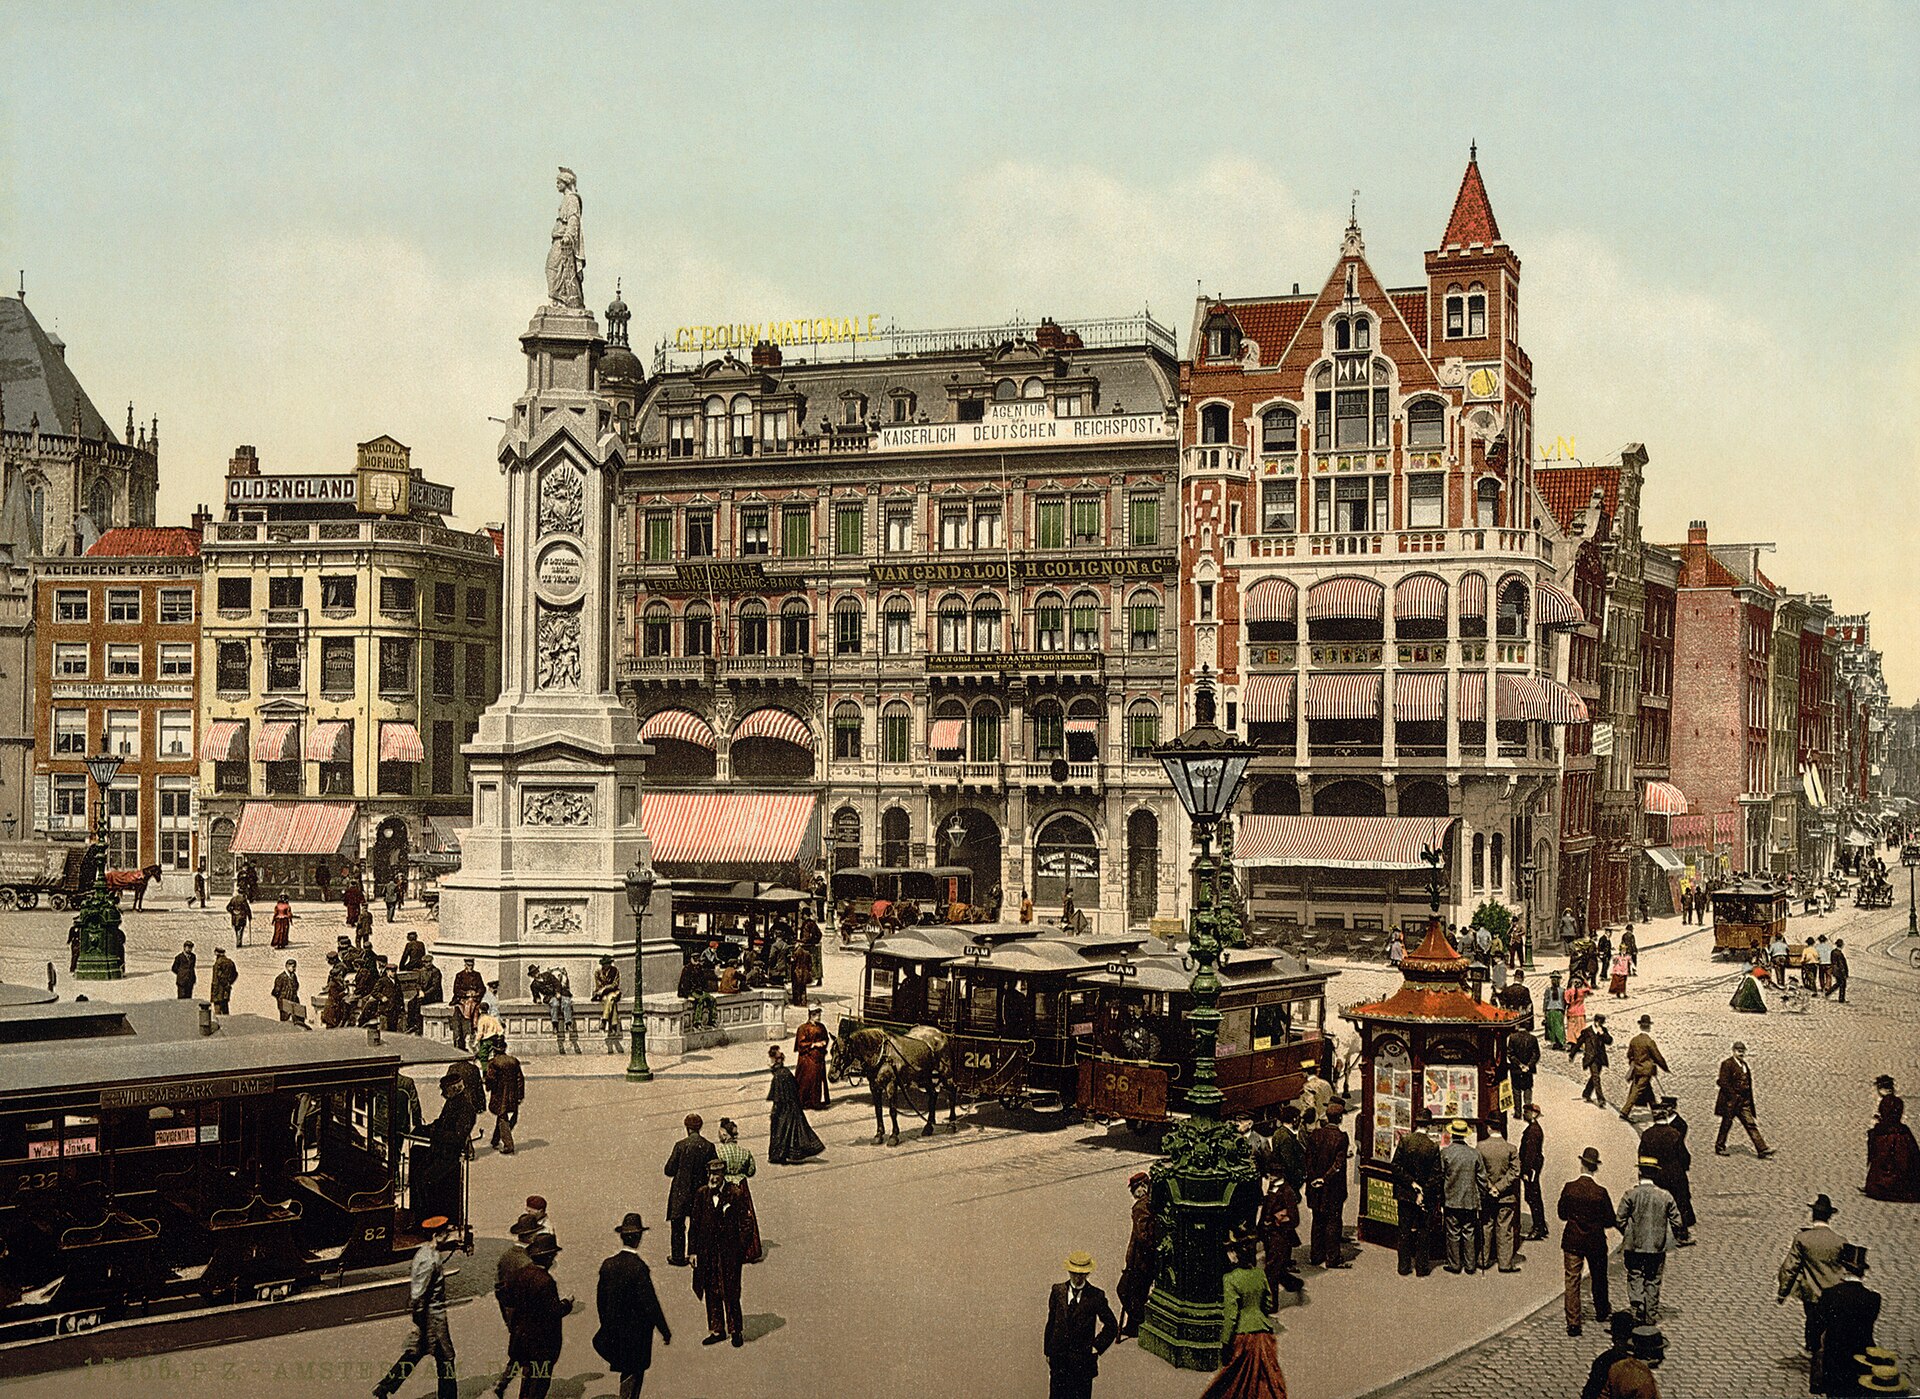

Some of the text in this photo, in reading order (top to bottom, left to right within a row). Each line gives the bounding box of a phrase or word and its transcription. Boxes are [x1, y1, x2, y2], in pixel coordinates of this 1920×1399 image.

[675, 313, 881, 351] GEBOUW NATIONALE
[991, 404, 1046, 418] AGENTUR
[883, 427, 956, 447] KAISERLICH
[973, 422, 1057, 442] DEUTSCHEN
[366, 443, 403, 455] RUDOLF
[364, 455, 406, 469] HOFHUIS
[230, 478, 356, 500] OLD ENGLAND
[410, 482, 452, 510] HEMISIER
[680, 564, 760, 580] NATONALE
[873, 566, 909, 580] VAN
[912, 565, 961, 580] GEND
[963, 567, 972, 578] &
[1044, 560, 1139, 576] COLIGNON
[1141, 563, 1150, 573] &
[966, 947, 989, 956] DAM
[1108, 963, 1135, 976] DAM
[964, 1051, 992, 1069] 214
[231, 1080, 260, 1094] DAM
[1104, 1073, 1130, 1092] 36
[364, 1226, 386, 1241] 82
